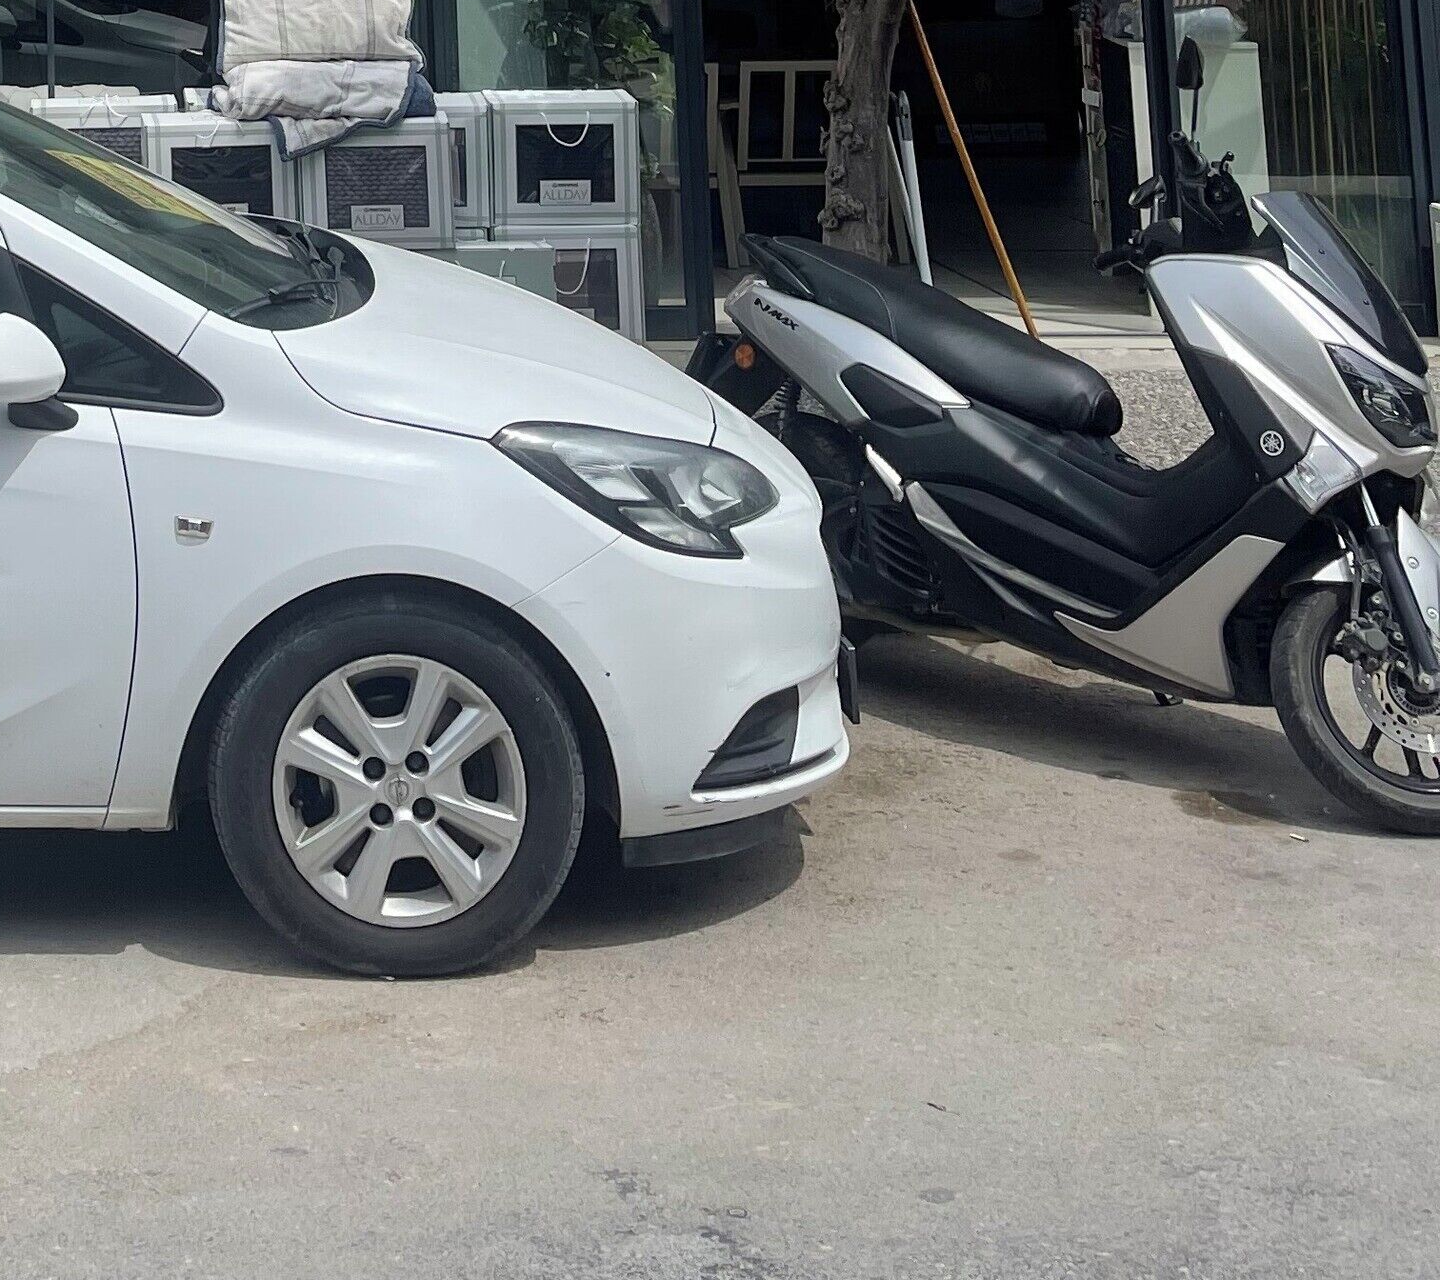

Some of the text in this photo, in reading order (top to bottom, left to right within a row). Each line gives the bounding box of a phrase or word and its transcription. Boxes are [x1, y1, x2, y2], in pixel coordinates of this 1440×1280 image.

[543, 189, 588, 201] ALLDAY
[354, 213, 401, 225] ALLDAY
[753, 297, 800, 331] NMAX
